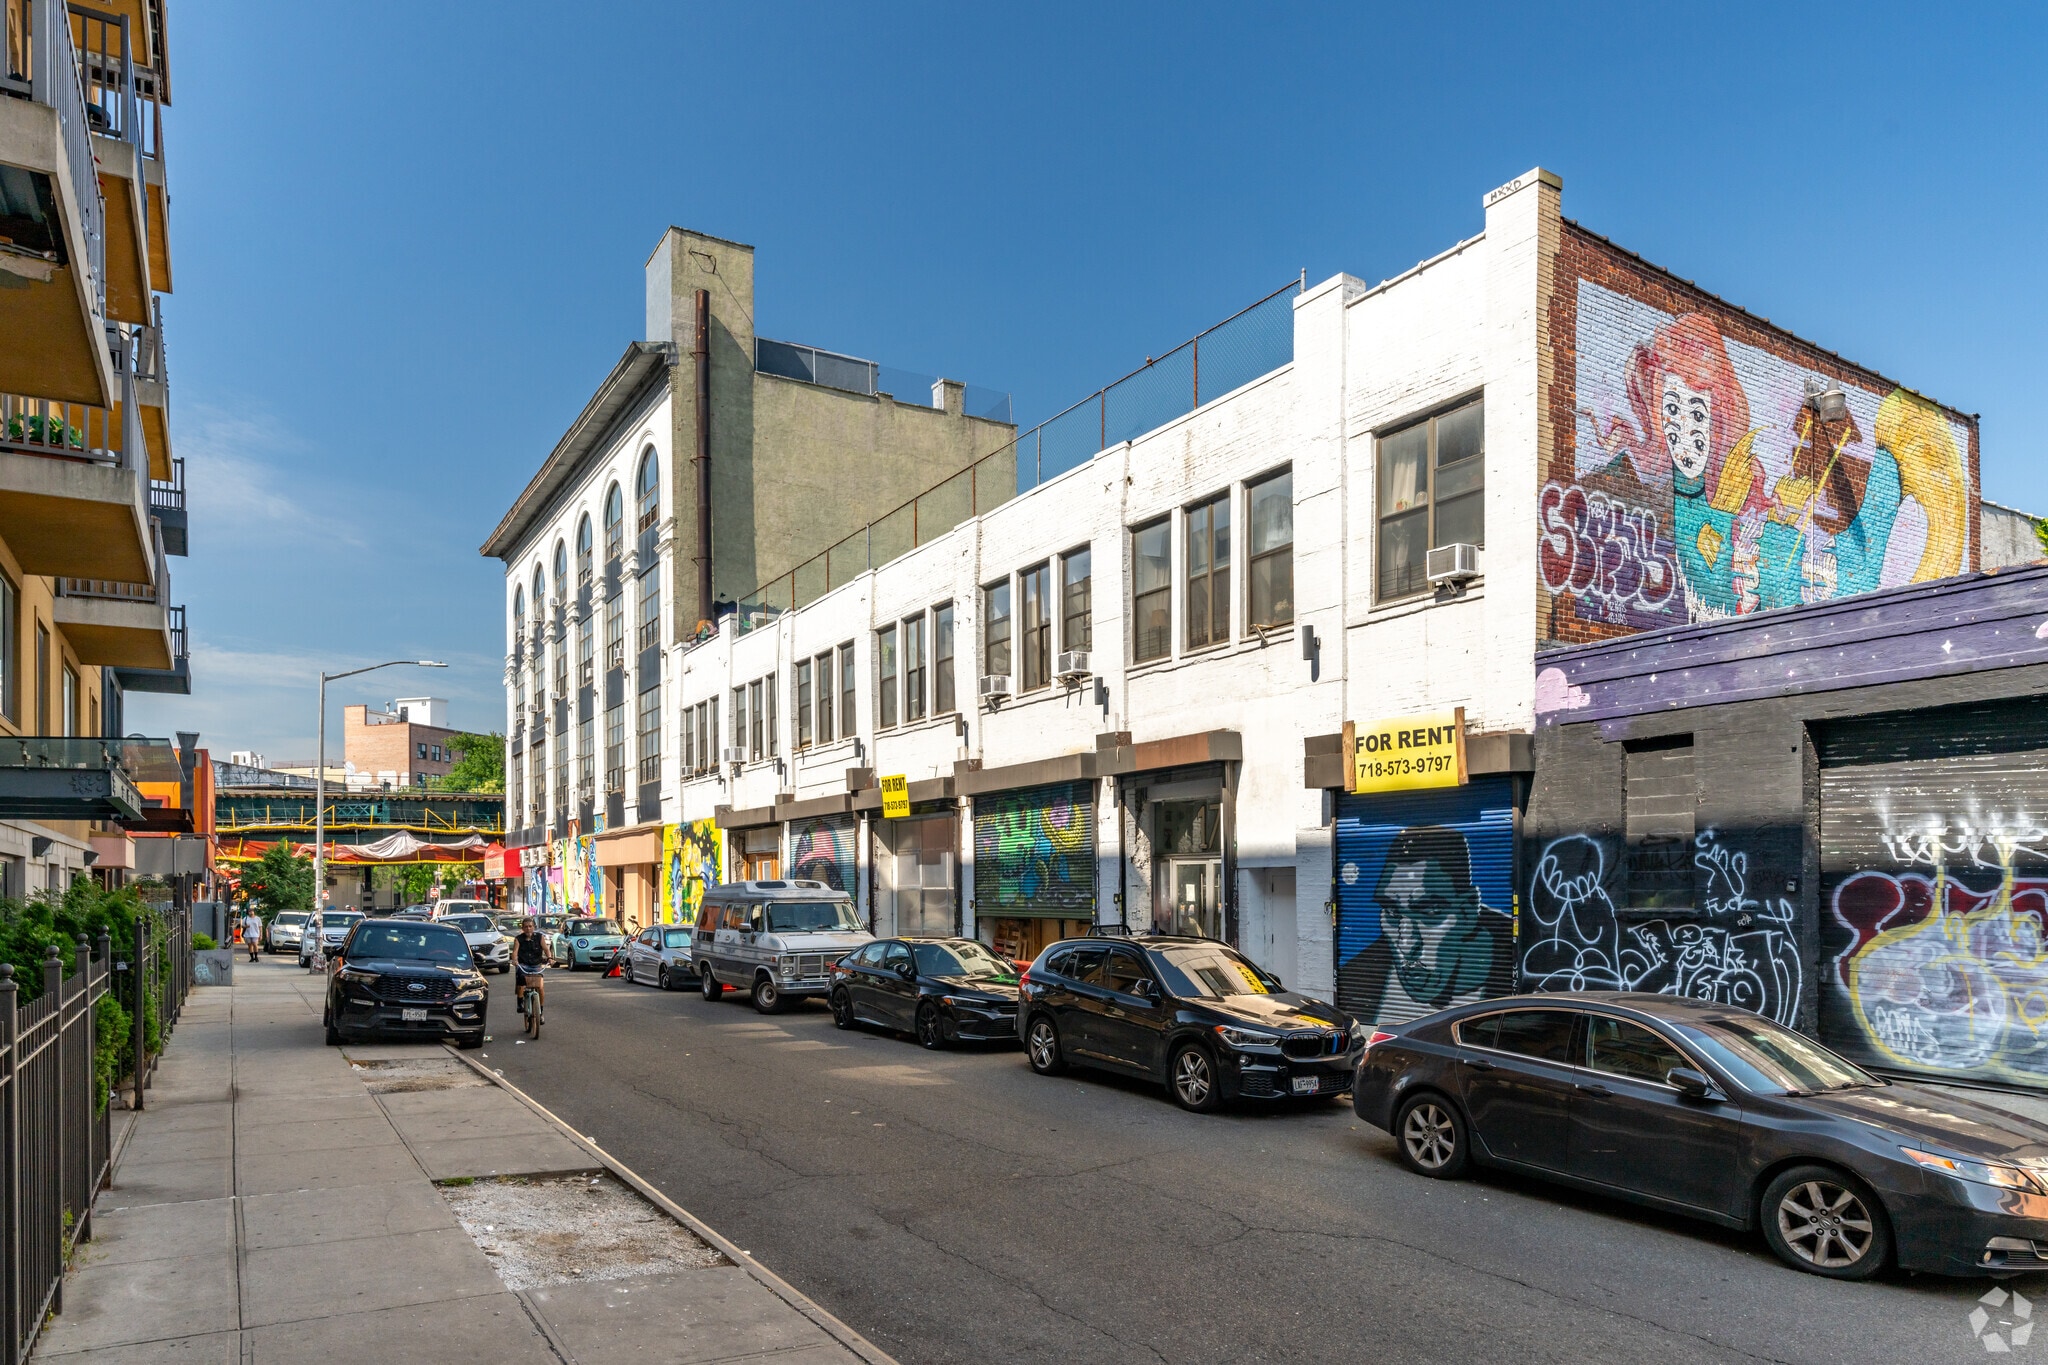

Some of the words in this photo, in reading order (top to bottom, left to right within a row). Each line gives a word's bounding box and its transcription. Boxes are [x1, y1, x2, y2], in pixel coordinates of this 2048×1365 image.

[1355, 733, 1393, 754] FOR
[1398, 724, 1456, 749] RENT
[1359, 755, 1452, 778] 718-573-9797
[881, 779, 892, 792] FOR
[892, 776, 906, 791] RENT
